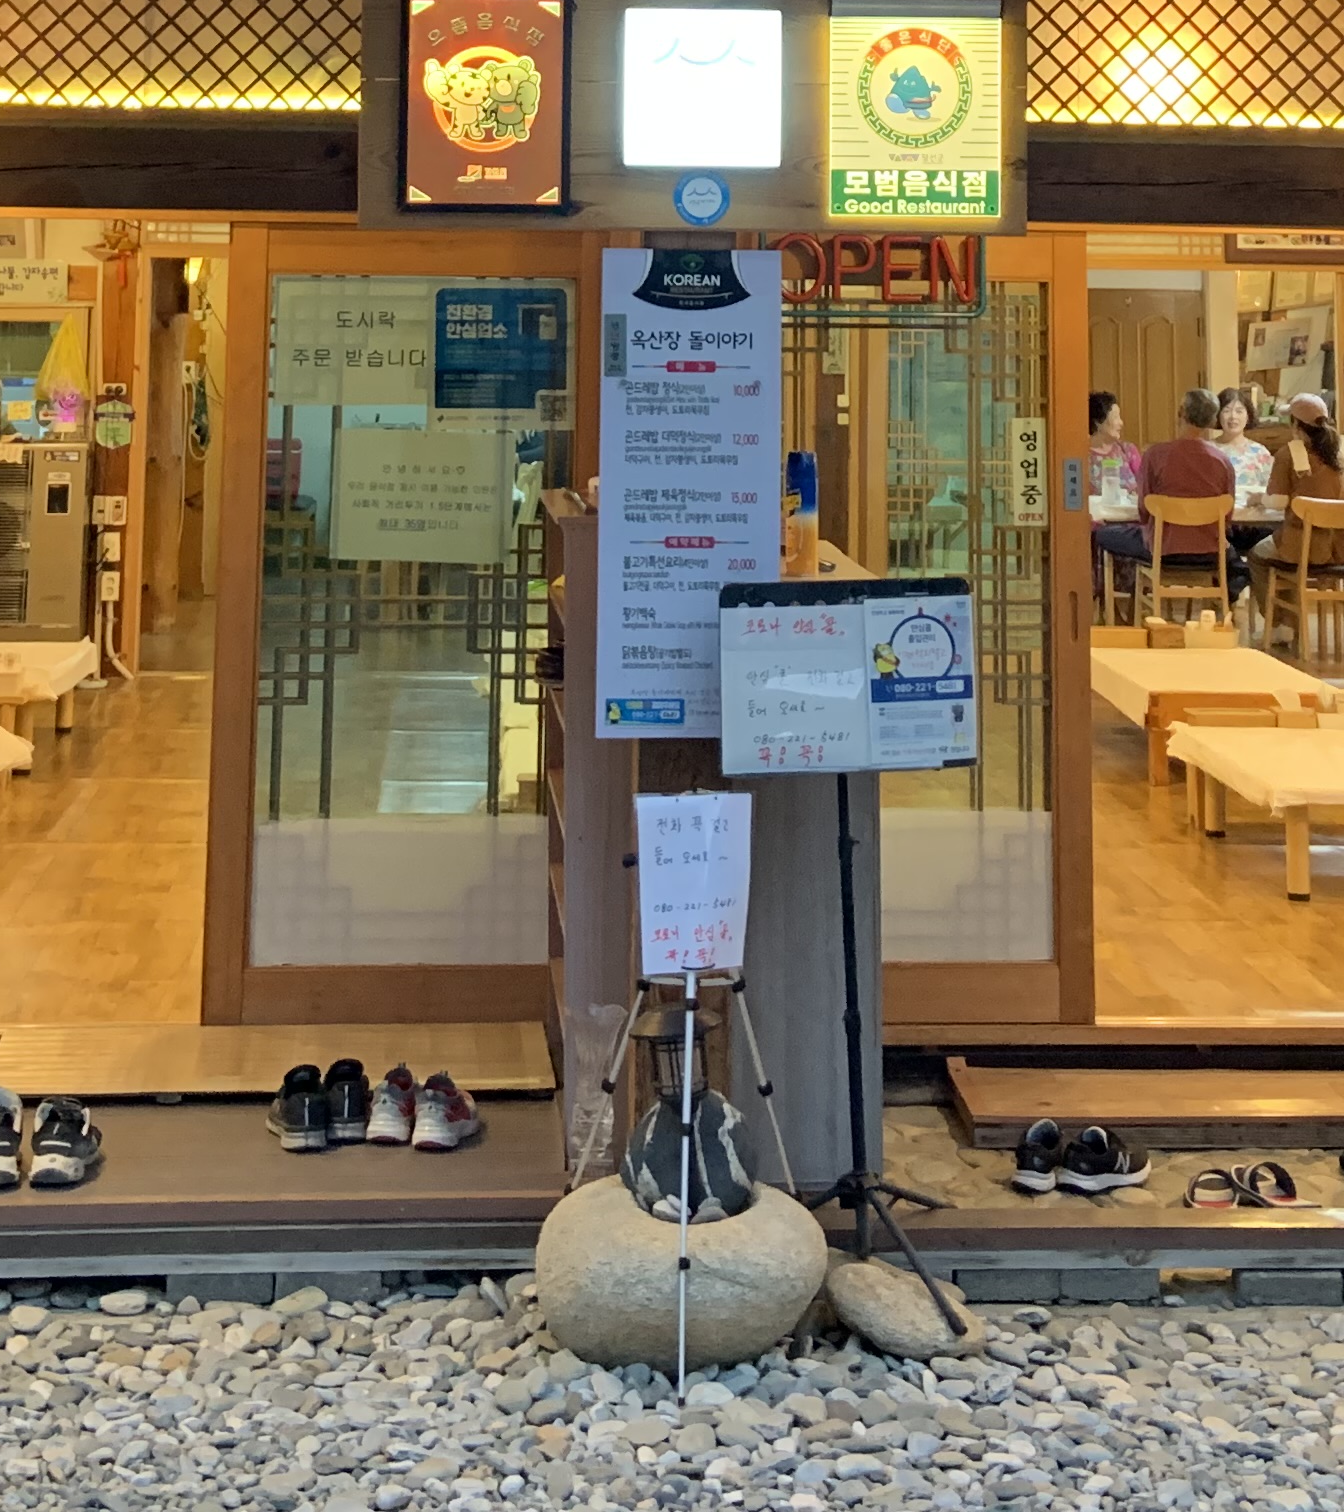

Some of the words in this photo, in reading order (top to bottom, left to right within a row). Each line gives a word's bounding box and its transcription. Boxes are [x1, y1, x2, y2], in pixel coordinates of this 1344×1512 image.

[843, 170, 987, 197] 모범음식점
[844, 199, 893, 214] Good
[898, 199, 986, 214] Restaurant
[775, 232, 974, 305] OPEN
[664, 273, 721, 287] KOREAN
[336, 310, 397, 329] 도시락
[631, 330, 681, 351] 옥산장
[688, 330, 753, 351] 돌이야기
[292, 349, 332, 368] 주문
[345, 348, 427, 368] 받습니다
[732, 433, 760, 447] 12,000
[1019, 430, 1042, 506] 영업중
[731, 492, 758, 505] 15,000
[1018, 512, 1044, 522] OPEN
[727, 558, 756, 571] 20,000
[622, 606, 656, 621] 황기백숙
[741, 617, 782, 637] 코로나
[753, 730, 850, 745] 080-221-5481
